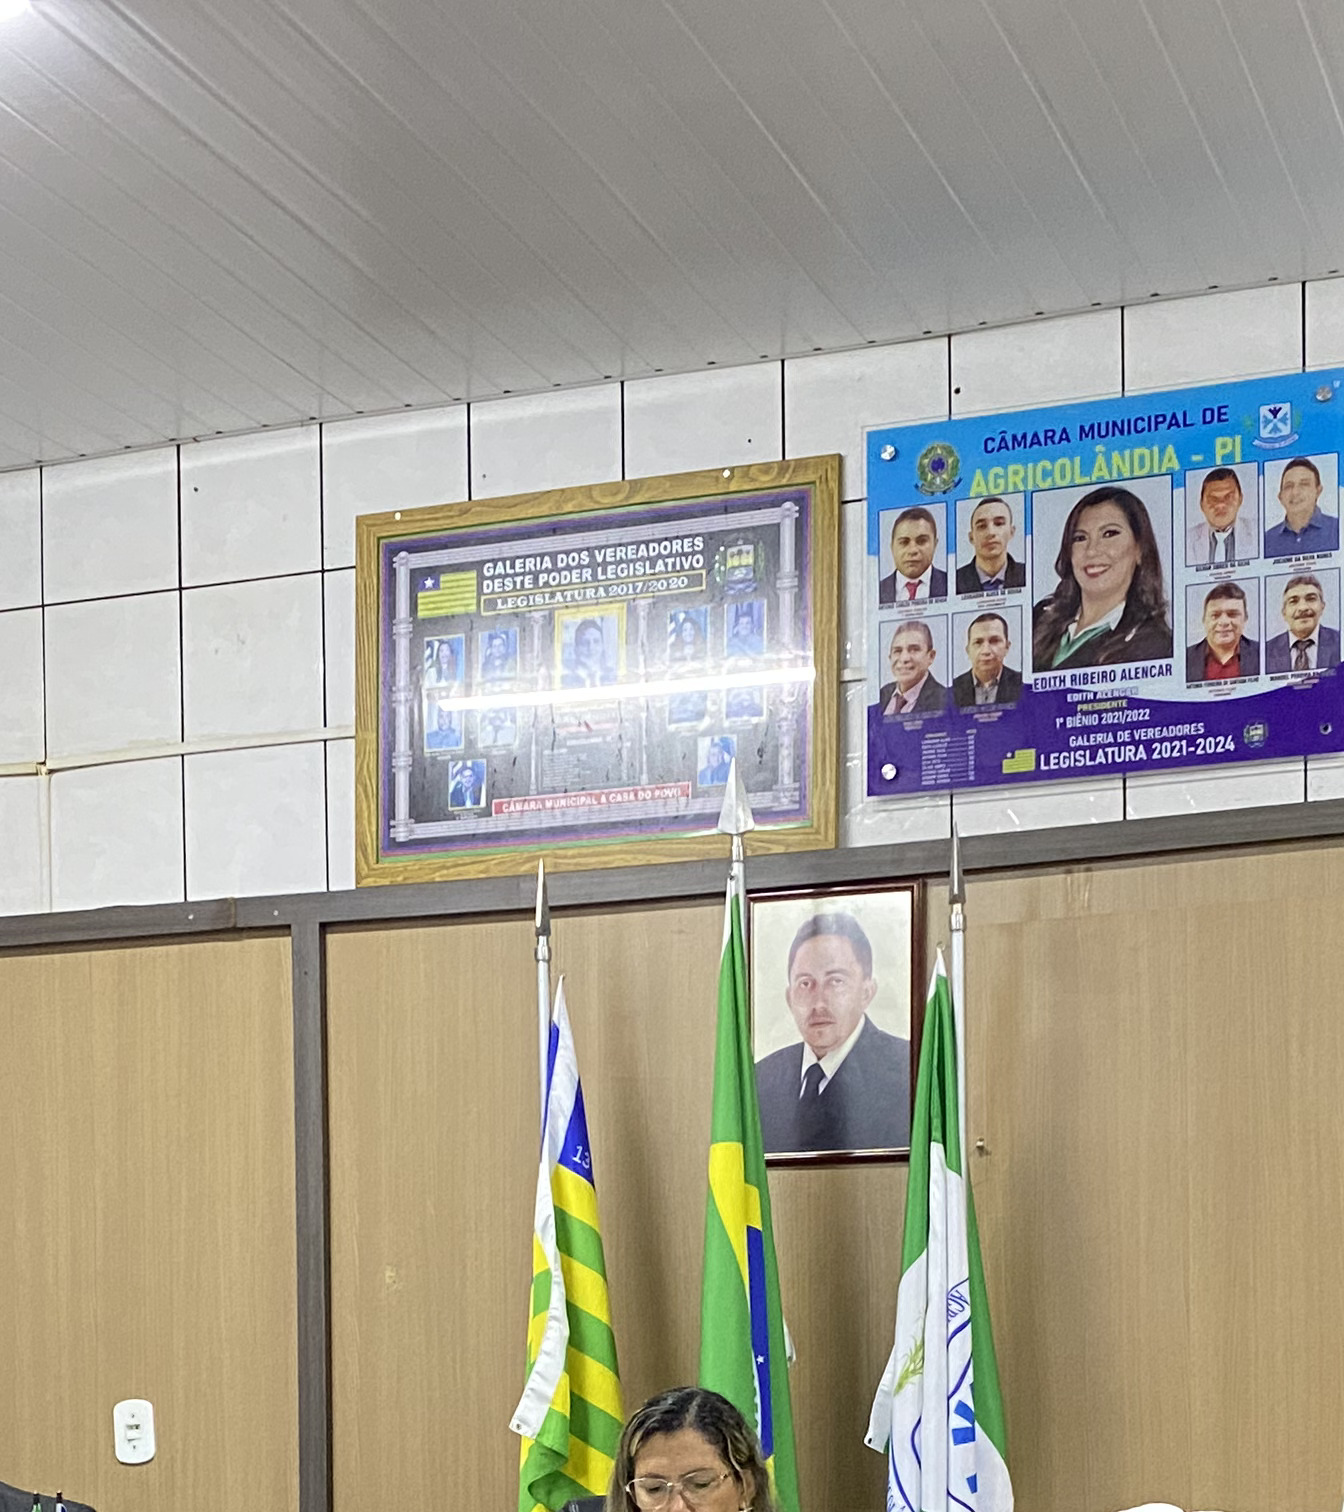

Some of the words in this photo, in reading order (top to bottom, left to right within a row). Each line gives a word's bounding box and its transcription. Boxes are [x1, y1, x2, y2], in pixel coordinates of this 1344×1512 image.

[983, 430, 1071, 454] CÂMARA
[1079, 410, 1195, 441] MUNICIPAL
[1201, 405, 1229, 425] DE
[969, 444, 1180, 497] AGRICOLÂNDIA
[1215, 435, 1242, 465] PI
[483, 555, 552, 577] GALERIA
[557, 551, 589, 568] DOS
[594, 536, 704, 563] VEREADORES
[482, 575, 534, 594] DESTE
[538, 567, 593, 587] PODER
[597, 554, 704, 581] LEGISLATIVO
[496, 586, 606, 610] LEGISLATURA
[1033, 675, 1067, 691] EDITH
[1070, 670, 1116, 687] RIBEIRO
[1120, 663, 1172, 682] ALENCAR
[1067, 691, 1094, 702] EDITH
[1096, 686, 1139, 698] ALENCAR
[1077, 699, 1128, 711] PRESIDENTE
[1066, 712, 1099, 729] BIÊNIO
[1101, 709, 1150, 724] 2021/2022
[1069, 731, 1115, 747] GALERIA
[1117, 730, 1130, 742] DE
[1132, 722, 1204, 740] VEREADORES
[1040, 744, 1147, 770] LEGISLATURA
[1151, 735, 1235, 759] 2021-2024
[502, 801, 543, 813] CÂMARA
[545, 795, 599, 809] MUNICIPAL
[609, 791, 636, 803] CASA
[638, 790, 651, 800] DO
